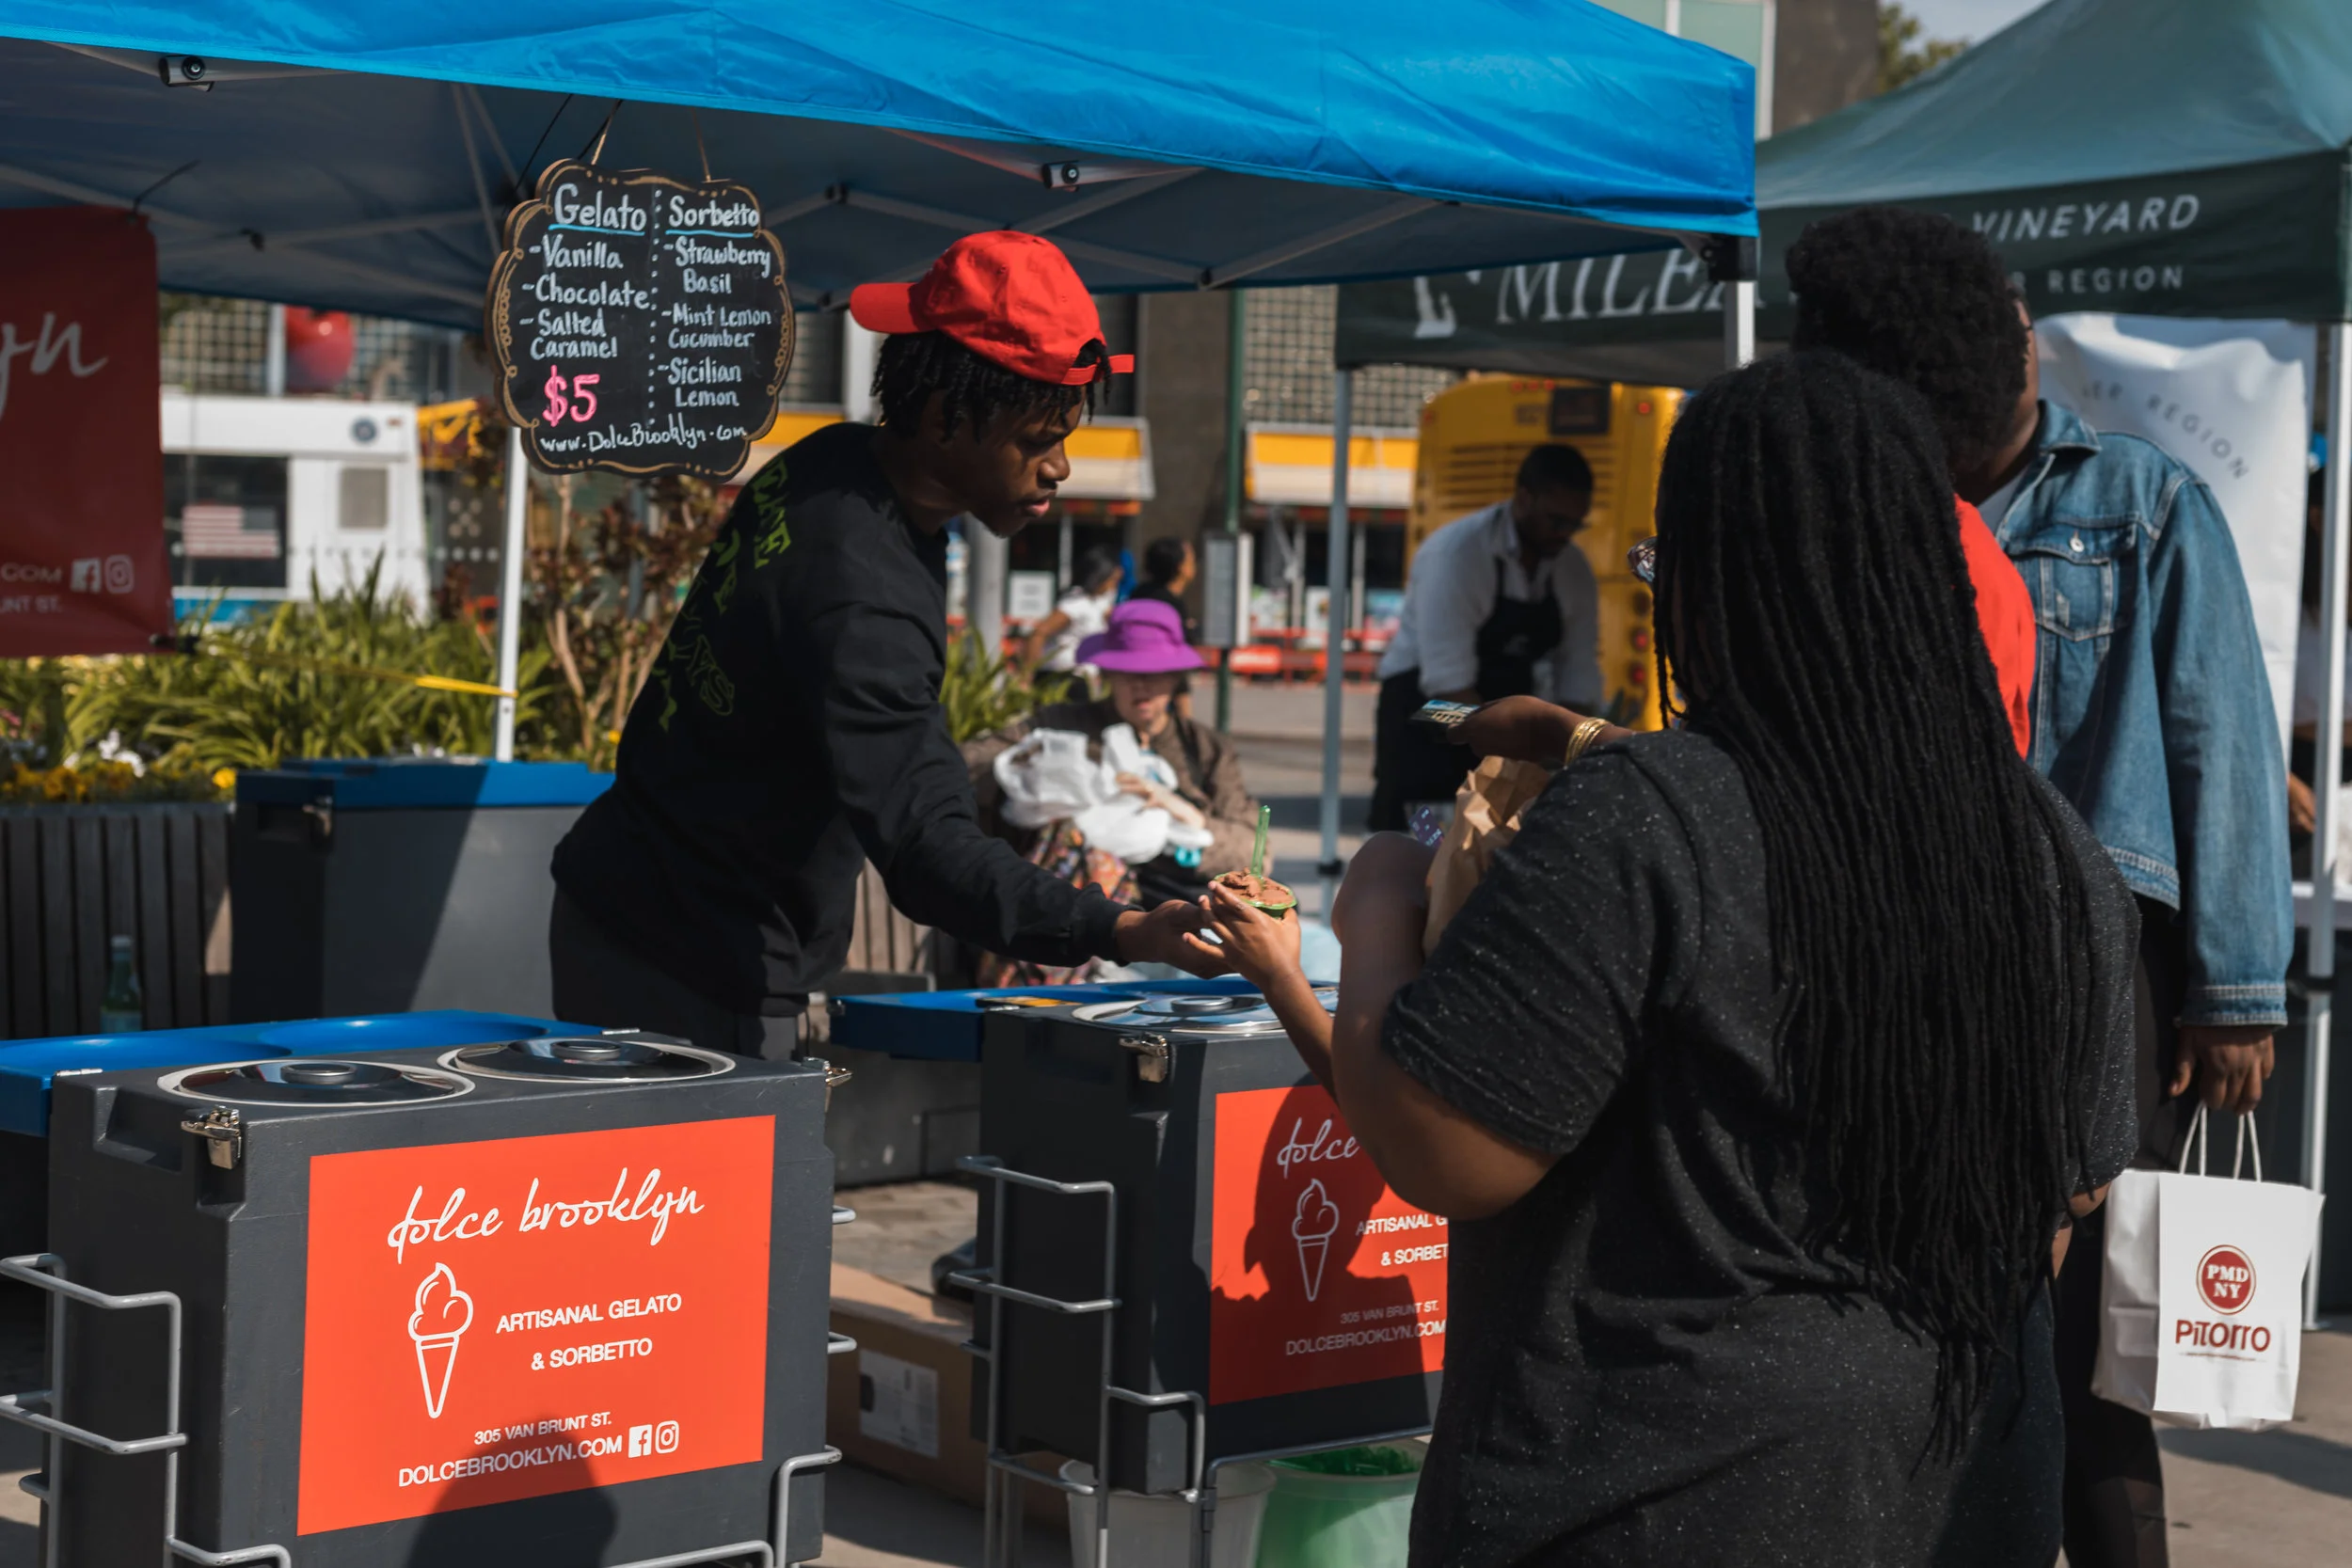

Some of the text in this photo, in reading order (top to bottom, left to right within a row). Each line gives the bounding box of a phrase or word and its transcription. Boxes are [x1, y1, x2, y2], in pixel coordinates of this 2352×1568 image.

[554, 182, 647, 231] Gelato
[669, 195, 760, 228] Sorbetto
[1973, 195, 2201, 243] VINEYARD
[683, 267, 732, 294] Basil
[2048, 264, 2184, 294] REGION
[720, 306, 771, 327] Lemon
[530, 337, 618, 360] Caramel
[668, 328, 755, 350] Cucumber
[543, 364, 601, 427] $5
[675, 387, 740, 407] Lemon
[1277, 1117, 1360, 1180] dolce
[387, 1167, 706, 1265] dolce brooklyn
[1355, 1213, 1433, 1236] ARTISANAL
[1380, 1251, 1391, 1266] &
[2206, 1264, 2249, 1283] PMD
[2213, 1282, 2242, 1299] NY
[496, 1293, 682, 1334] ARTISANAL GELATO
[1341, 1299, 1439, 1324] 305 VAN BRUNT ST.
[1285, 1319, 1447, 1356] DOLCEBROOKLYN.COM
[531, 1337, 653, 1370] & SORBETTO
[473, 1411, 612, 1445] 305 VAN BRUNT ST.
[398, 1435, 623, 1487] DOLCEBROOKLYN.COM
